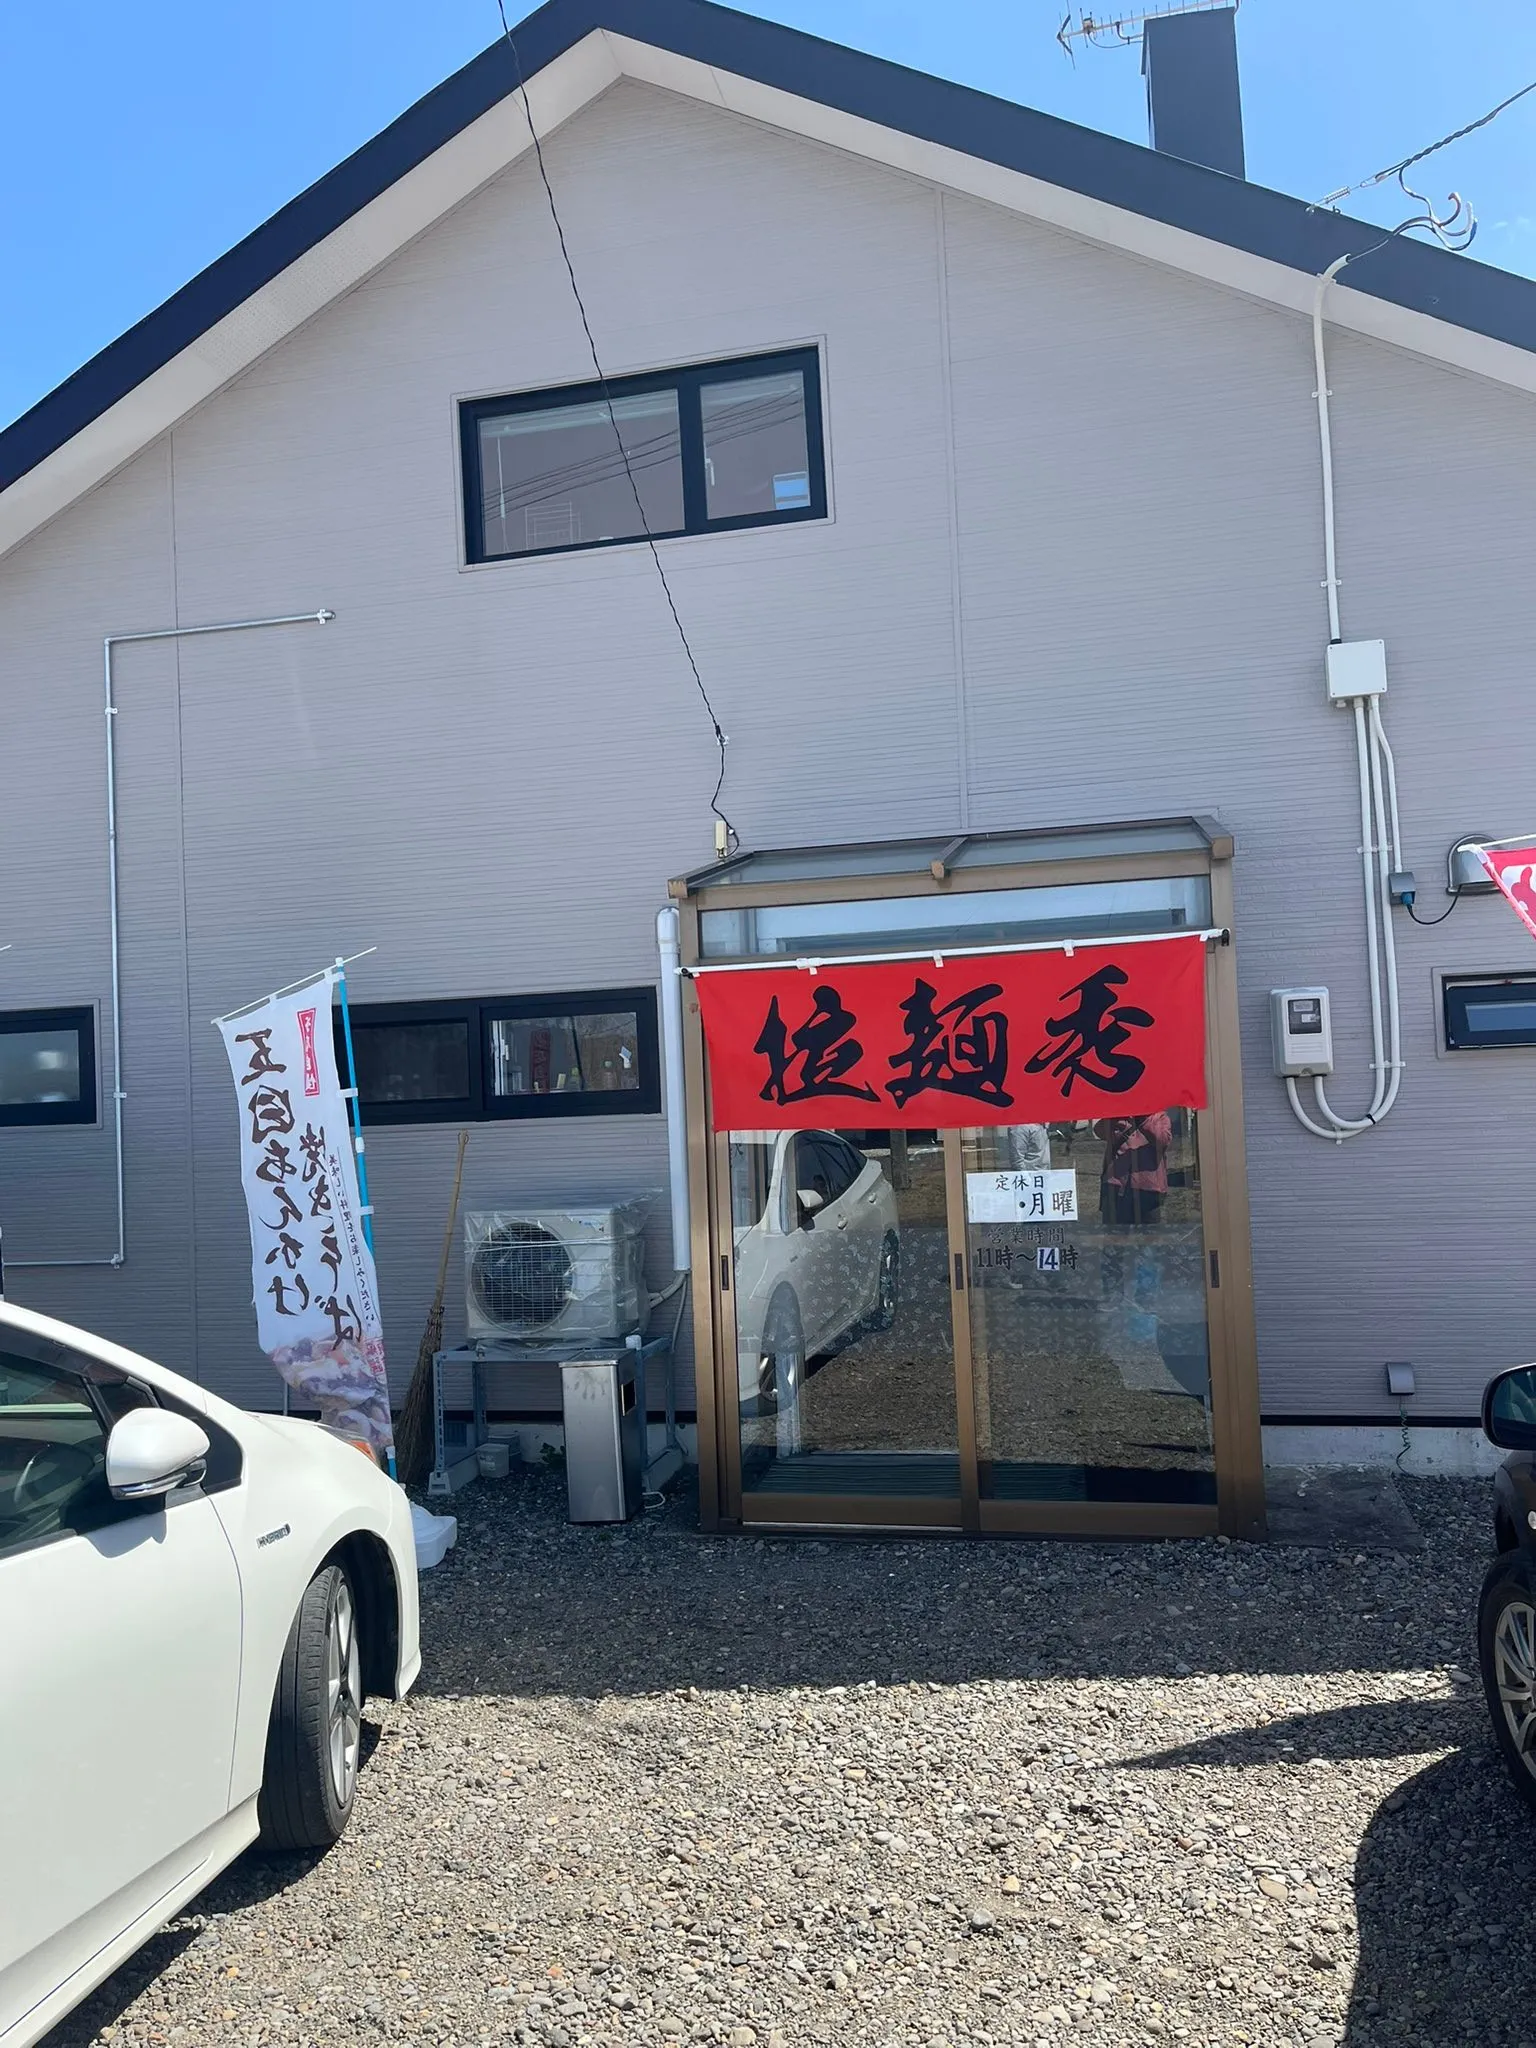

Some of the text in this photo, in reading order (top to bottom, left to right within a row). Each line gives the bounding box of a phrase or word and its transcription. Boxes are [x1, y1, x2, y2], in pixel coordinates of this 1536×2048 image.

[995, 1175, 1044, 1191] 定休日
[988, 1228, 1064, 1244] 営業時間
